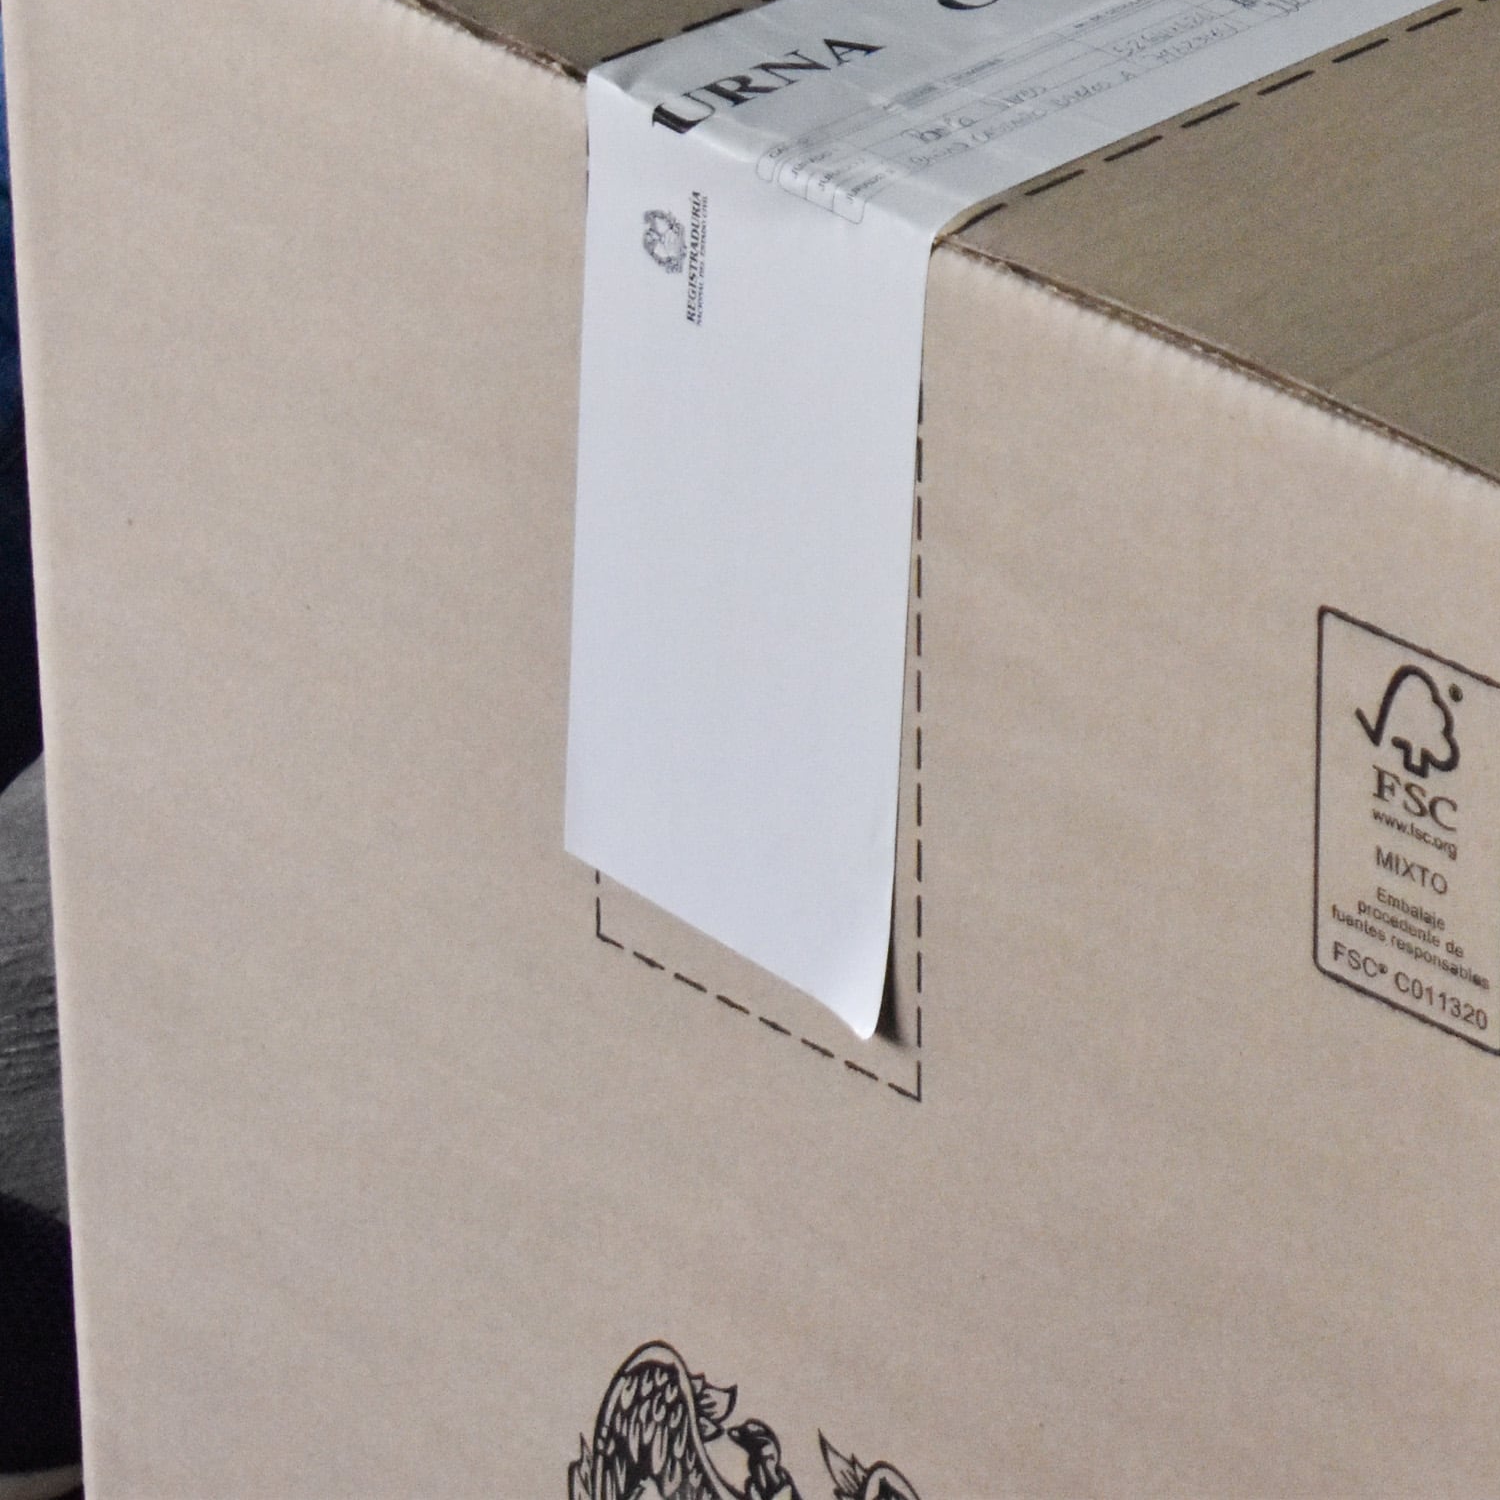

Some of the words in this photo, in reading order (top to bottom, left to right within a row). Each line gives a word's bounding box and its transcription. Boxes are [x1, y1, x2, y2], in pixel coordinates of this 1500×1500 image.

[651, 36, 886, 134] URNA
[1372, 764, 1459, 833] FSC
[1371, 805, 1459, 861] www.fsc.org
[1375, 846, 1449, 896] MIXTO
[1357, 900, 1442, 950] procedente
[1446, 939, 1465, 959] de
[1376, 886, 1447, 932] Embalaje
[1331, 904, 1388, 944] fuentes
[1390, 933, 1491, 991] responsables
[1394, 970, 1489, 1031] C011320
